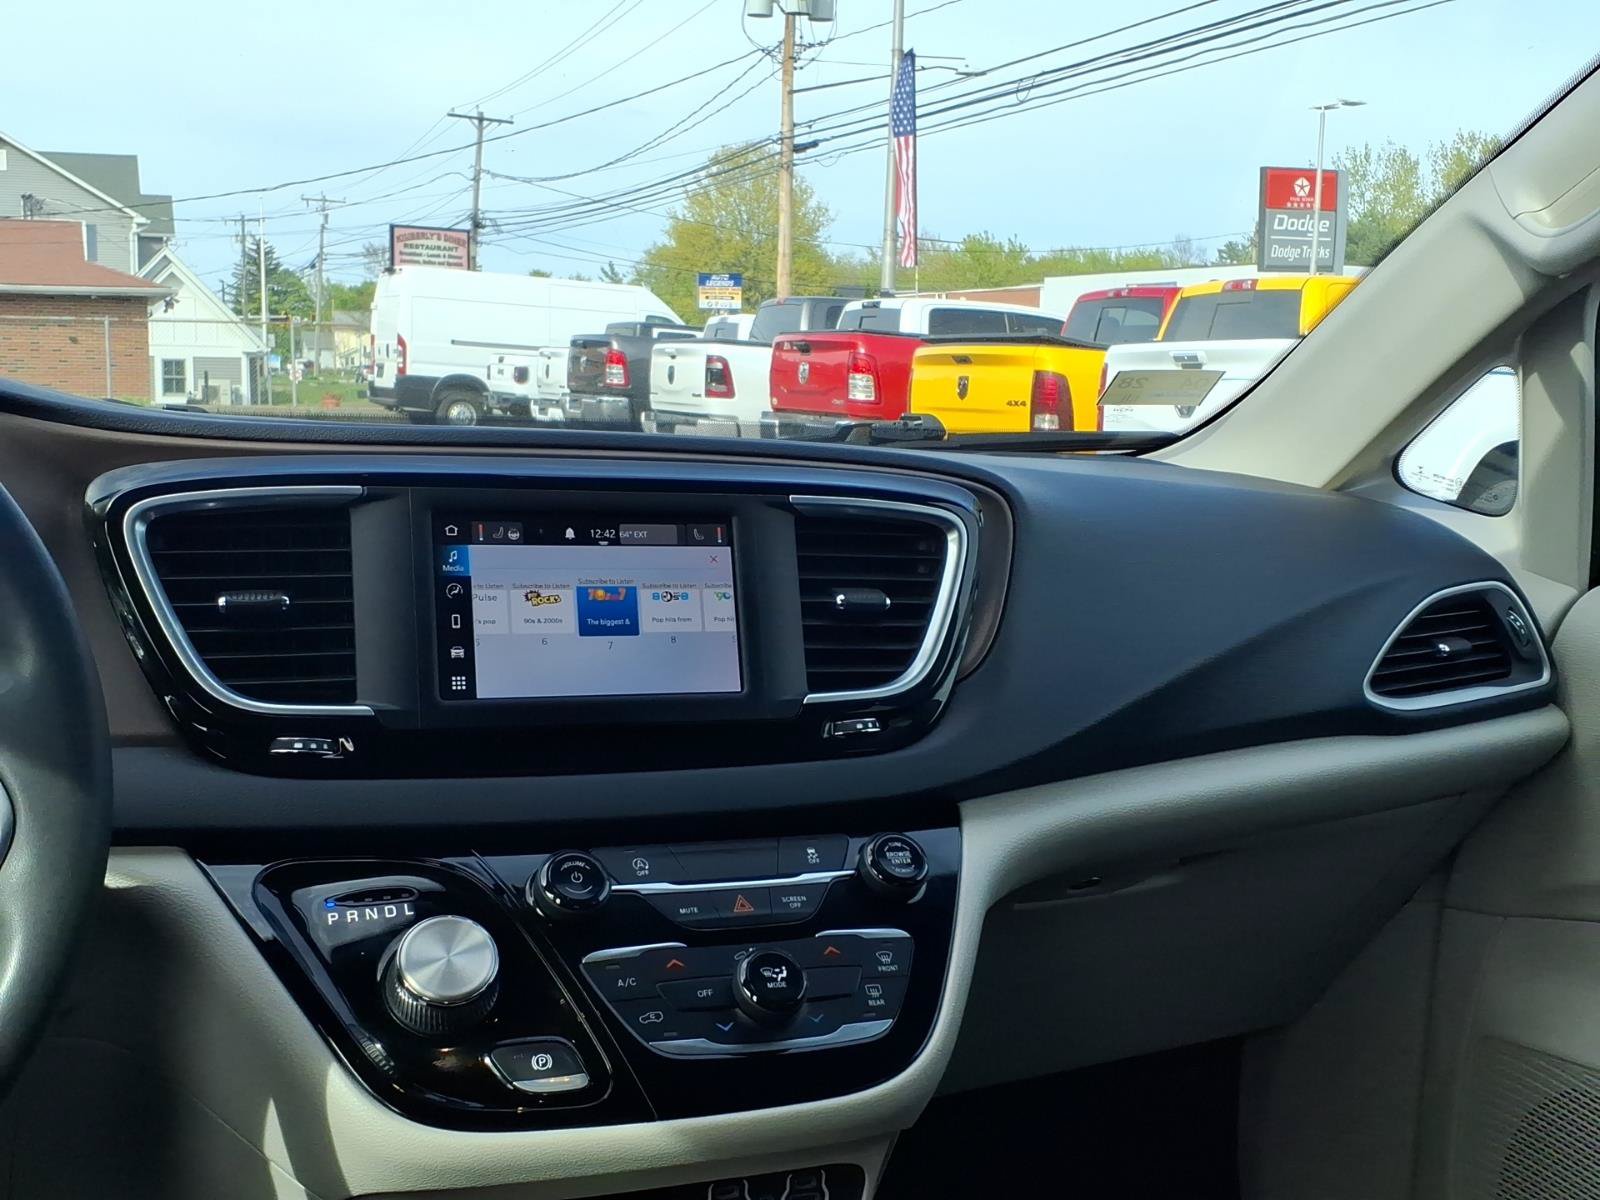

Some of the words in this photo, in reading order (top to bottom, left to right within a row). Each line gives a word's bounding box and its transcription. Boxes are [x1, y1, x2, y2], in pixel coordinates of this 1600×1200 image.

[403, 243, 459, 252] RESTAURANT
[1271, 244, 1301, 261] Dodge
[1302, 245, 1330, 259] Trks
[590, 529, 616, 539] 12:42
[634, 531, 648, 539] EXT
[578, 577, 609, 585] Subscribe
[600, 617, 624, 627] biggest
[652, 617, 664, 625] Pop
[541, 638, 548, 646] 6
[671, 635, 677, 644] 8
[608, 641, 614, 650] 7
[878, 964, 898, 972] FRONT
[617, 977, 637, 988] A/C
[767, 981, 787, 989] MODE
[697, 989, 713, 997] OFF
[868, 999, 886, 1007] REAR
